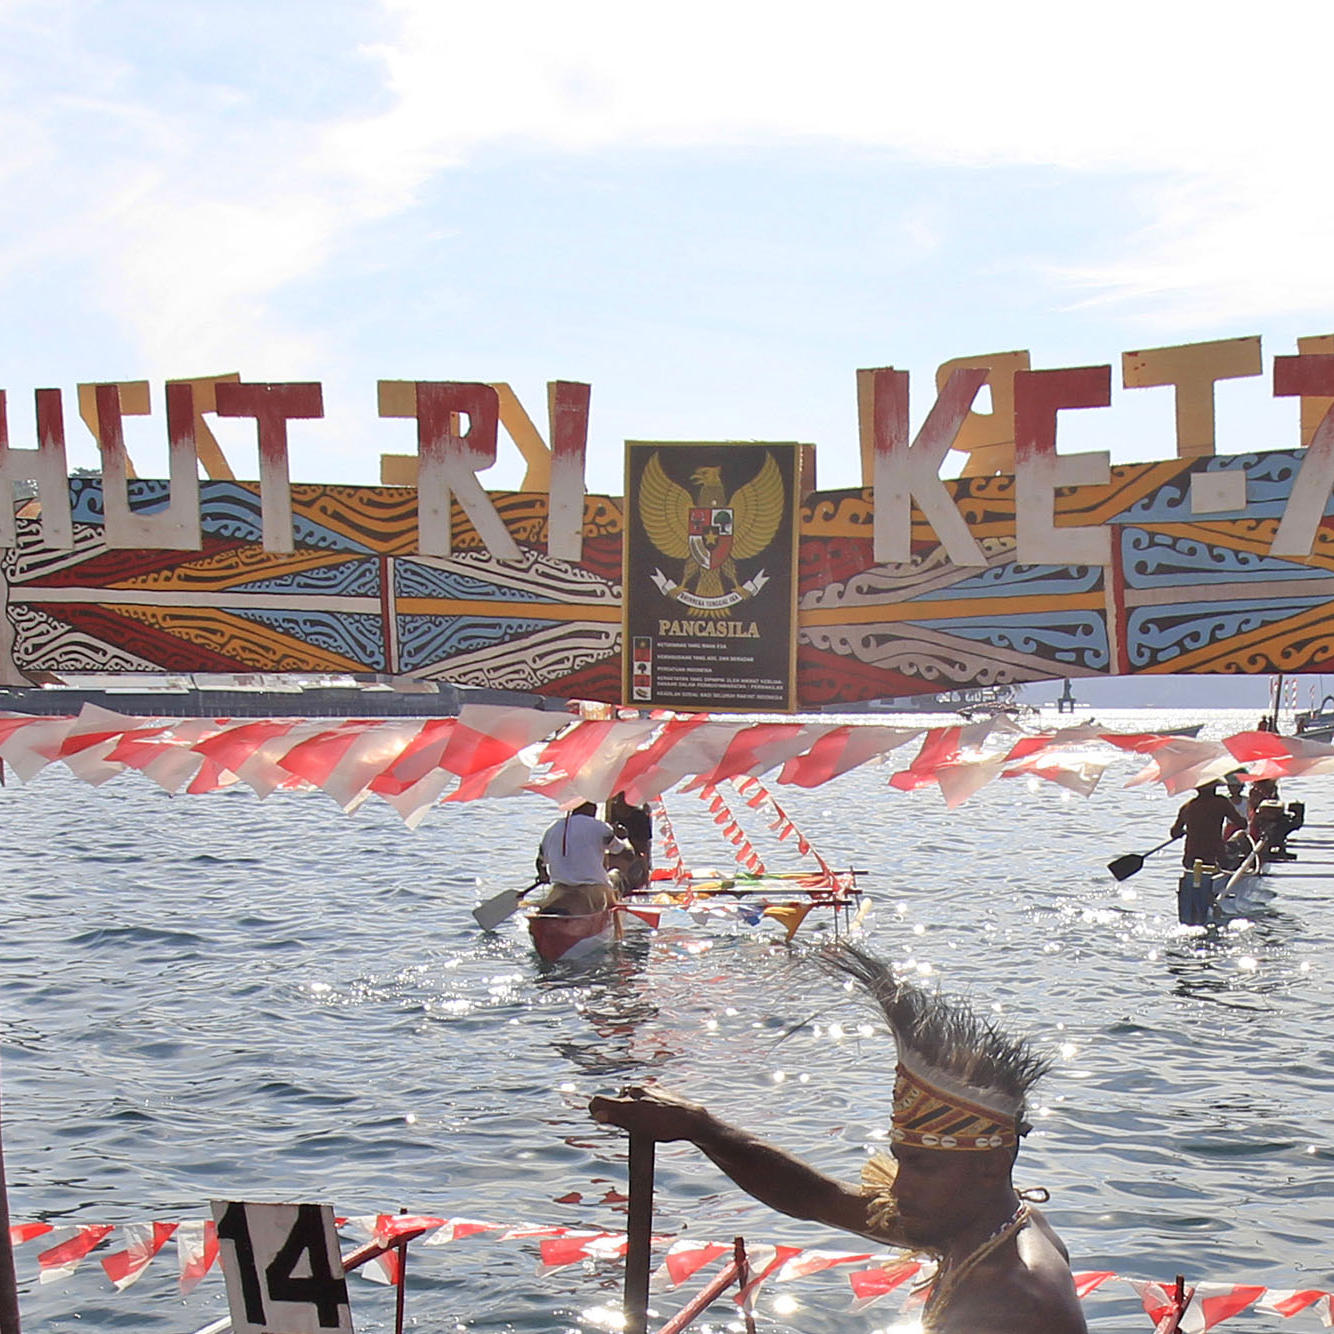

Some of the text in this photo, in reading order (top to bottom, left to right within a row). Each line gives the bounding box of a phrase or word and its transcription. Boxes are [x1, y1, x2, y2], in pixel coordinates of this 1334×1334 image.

[415, 380, 591, 562] RI
[658, 619, 760, 638] PANCASILA
[217, 1201, 349, 1329] 14
